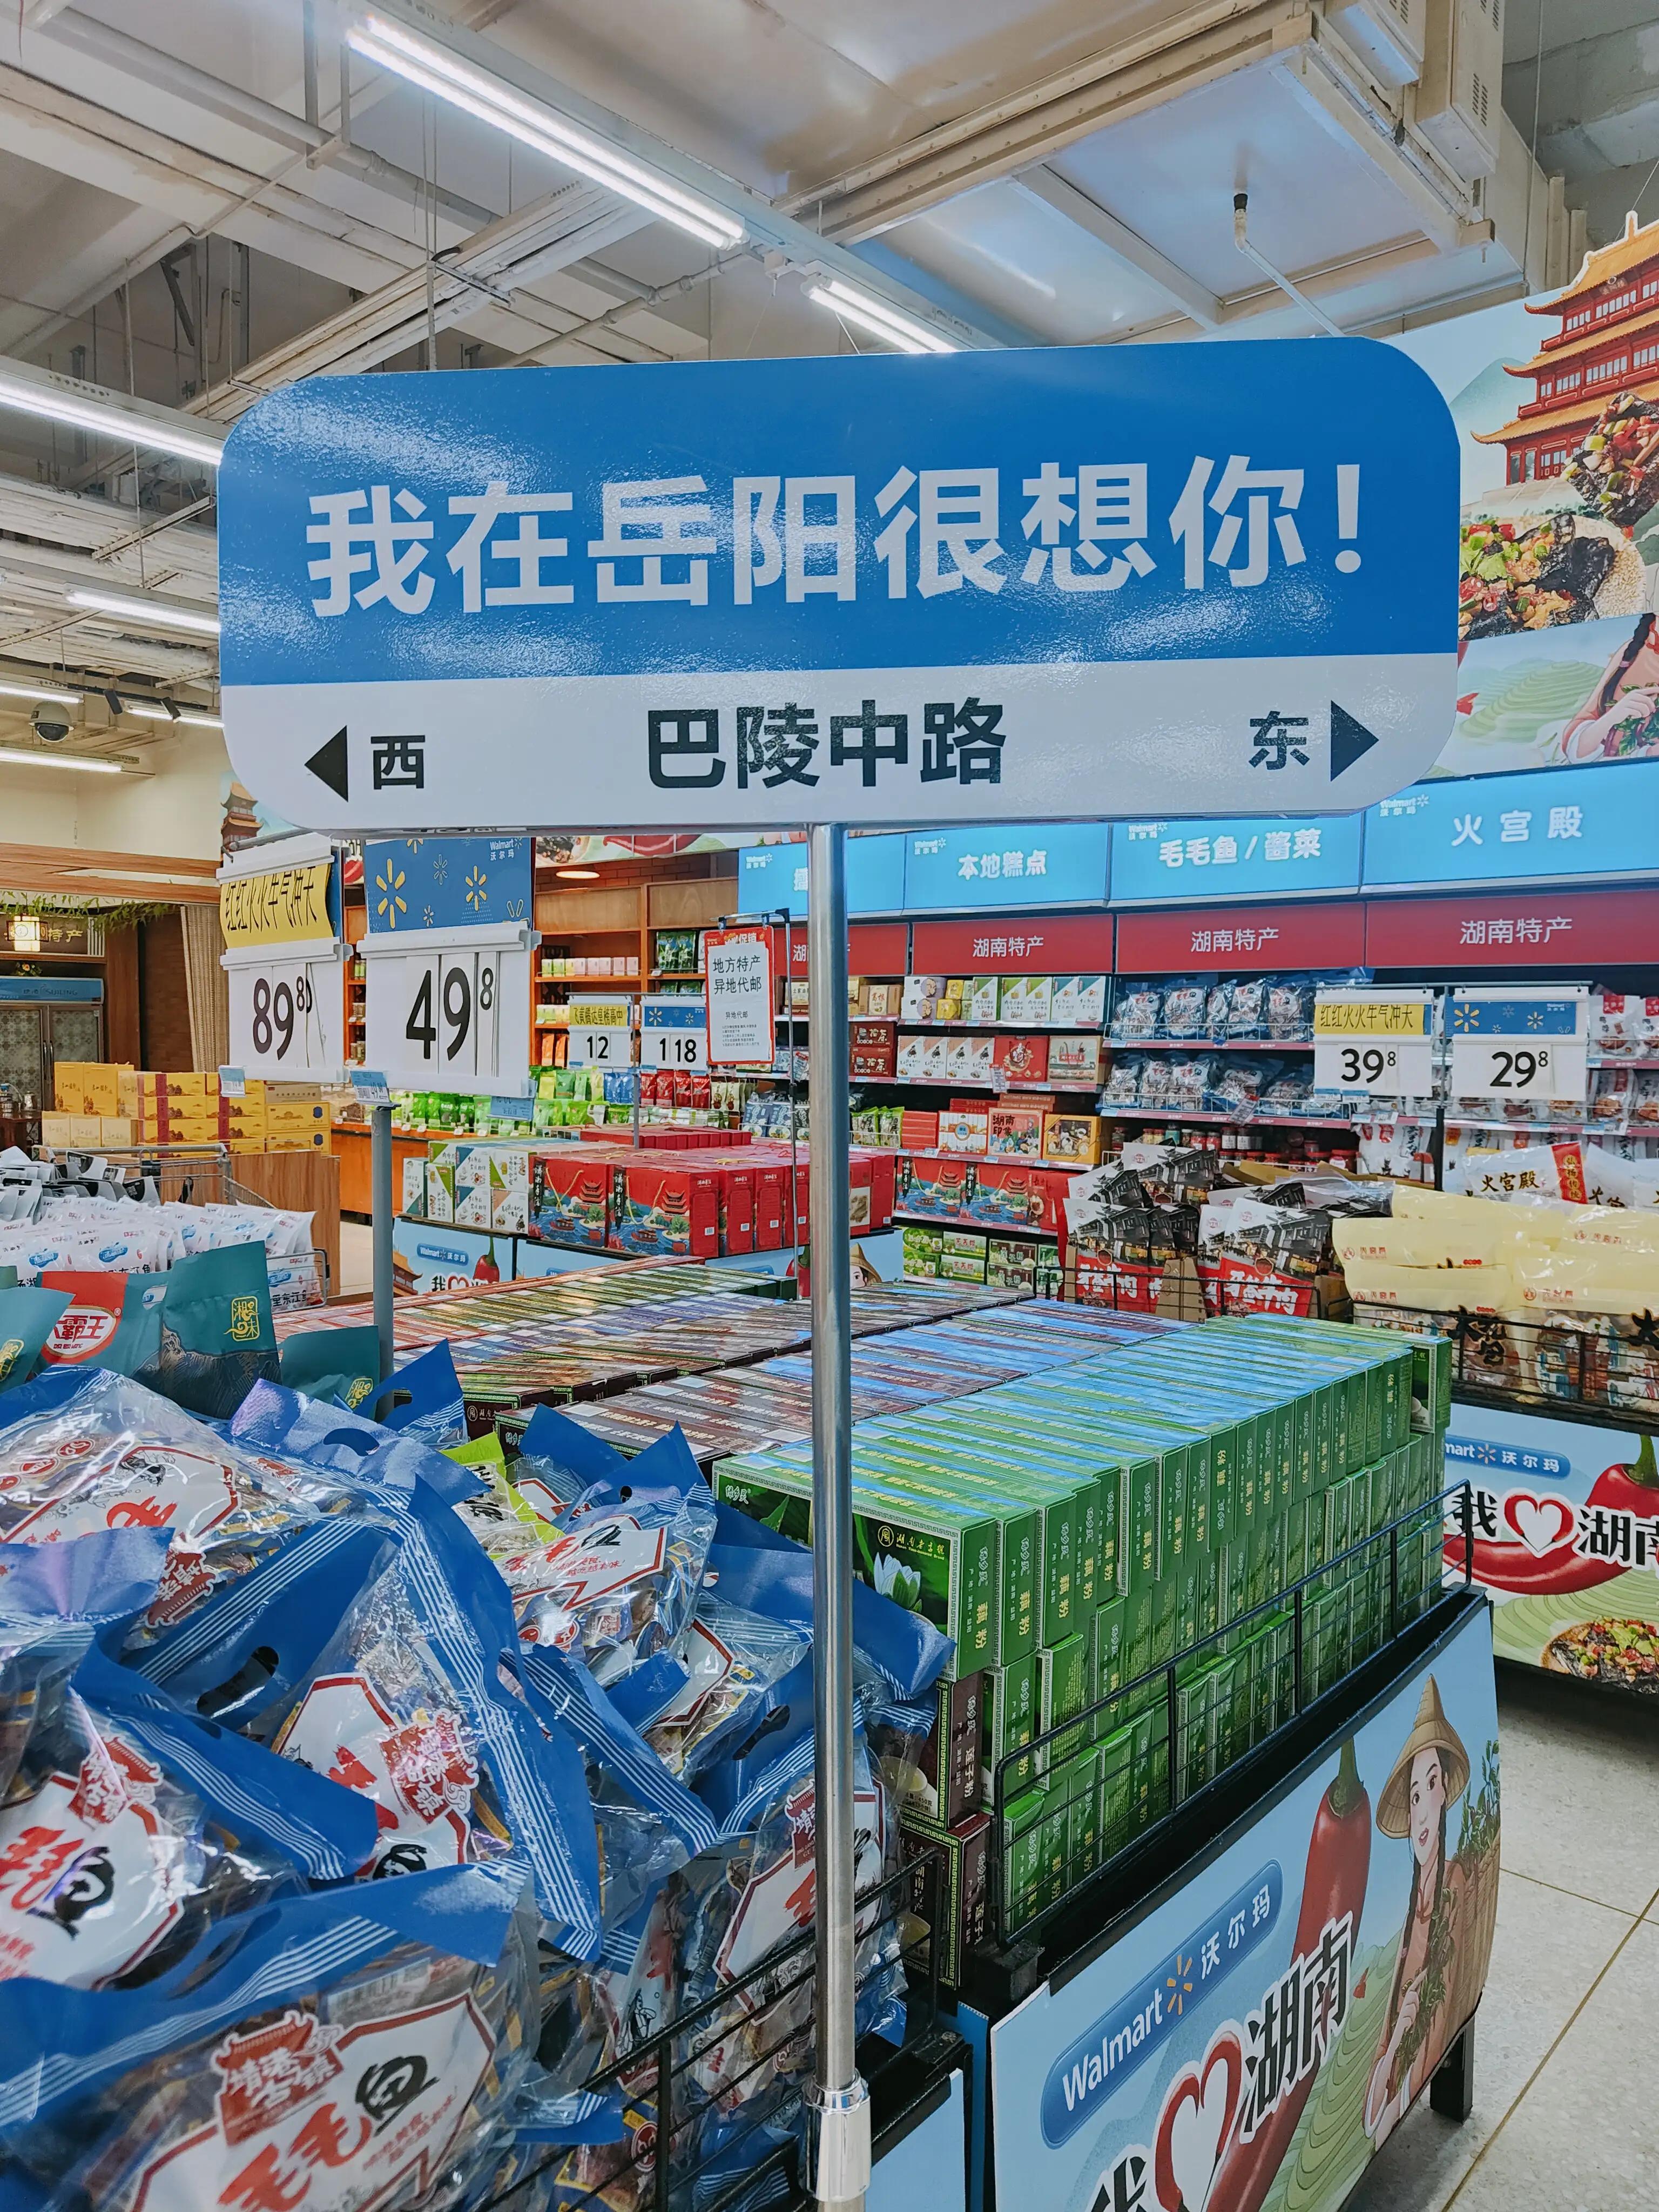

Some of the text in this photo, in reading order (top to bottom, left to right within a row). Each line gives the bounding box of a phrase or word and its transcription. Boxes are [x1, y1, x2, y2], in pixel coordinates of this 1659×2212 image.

[305, 454, 1362, 617] 我在岳阳很想你！
[648, 698, 1008, 791] 巴陵中路
[1248, 711, 1310, 769] 东
[370, 734, 426, 790] 西
[1451, 806, 1583, 846] 火宫殿
[490, 839, 514, 850] Walmart
[490, 849, 514, 860] 沃尔玛
[958, 849, 1047, 880] 本地糕点
[1191, 927, 1279, 952] 湖南特产
[1460, 916, 1574, 945] 湖南特产
[973, 935, 1044, 957] 湖南特产
[713, 955, 761, 973] 地方特产
[714, 976, 761, 995] 异地代邮
[725, 1011, 748, 1020] 异地代邮
[1320, 1004, 1413, 1029] 红红火火牛气冲天
[587, 1035, 608, 1059] 12
[993, 1114, 1015, 1126] 湖南
[1481, 1172, 1540, 1192] 火宫殿
[420, 1246, 466, 1263] Walmart 沃尔玛
[431, 1275, 446, 1290] 我
[53, 1315, 109, 1343] 霸王
[1445, 1444, 1559, 1473] mart 沃尔玛
[1451, 1491, 1498, 1538] 我
[1058, 1573, 1070, 1618] 藕粉
[975, 1601, 988, 1649] 藕粉
[1019, 1590, 1031, 1636] 藕粉
[964, 1746, 975, 1798] 莲子粉
[1062, 1885, 1271, 2112] Walmart 沃尔玛
[1243, 1917, 1351, 2133] 湖南
